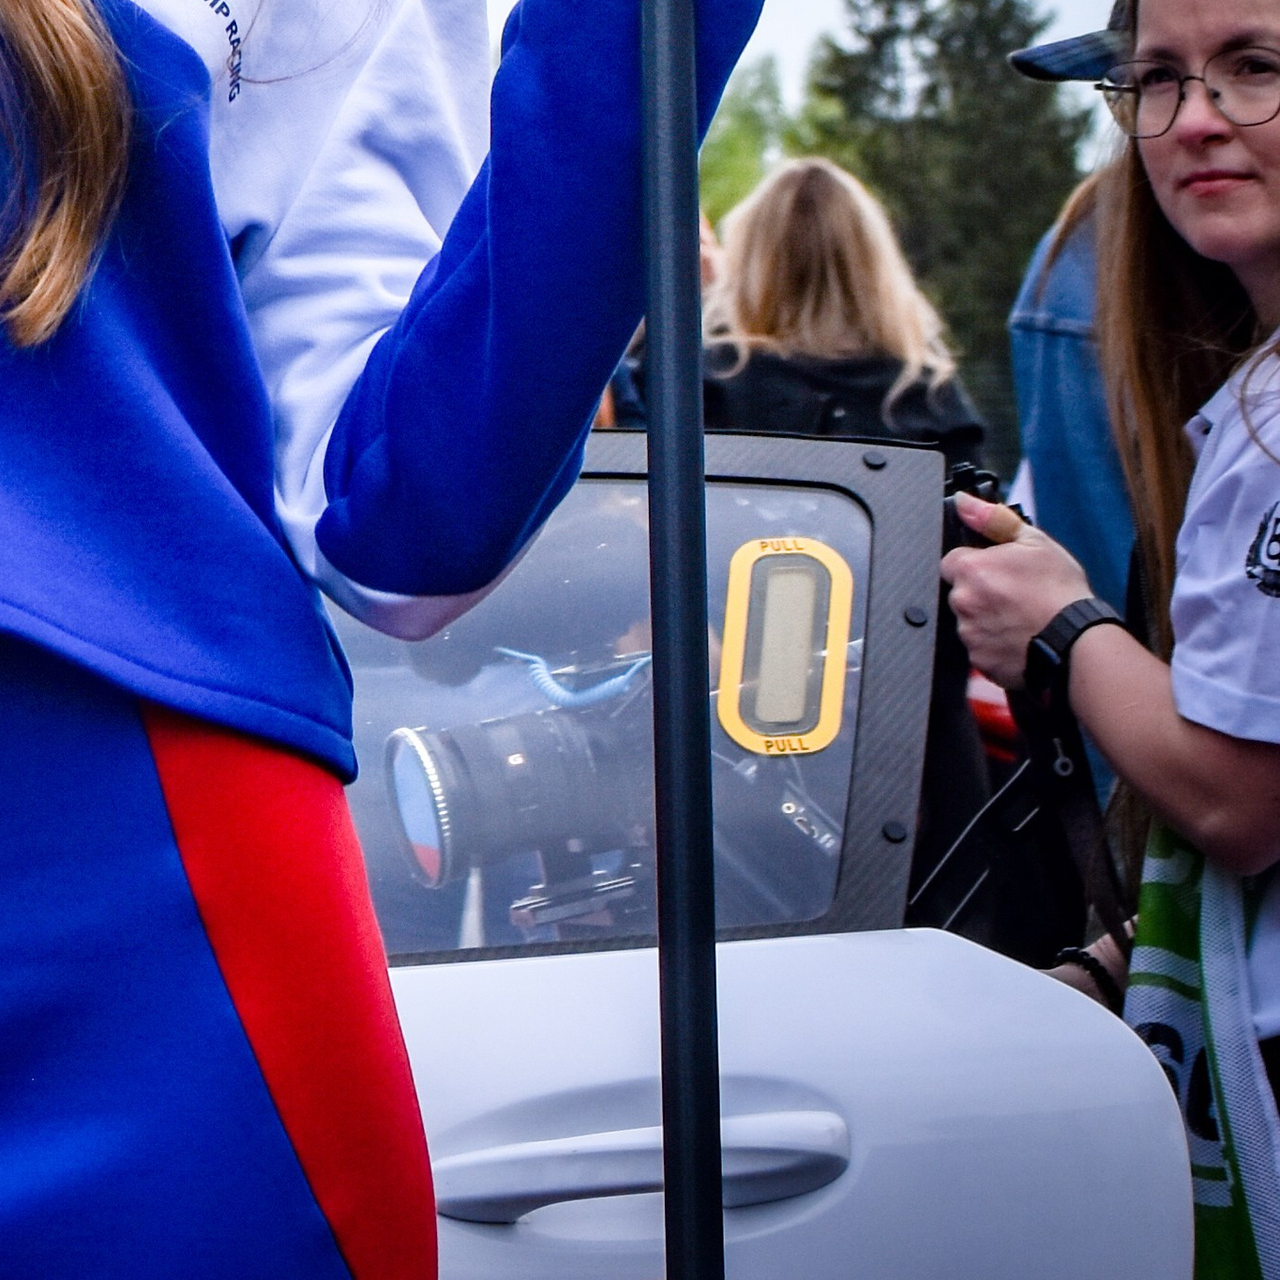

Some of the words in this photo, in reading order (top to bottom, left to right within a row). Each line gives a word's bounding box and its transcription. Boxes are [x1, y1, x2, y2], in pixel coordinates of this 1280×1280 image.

[225, 19, 242, 103] RACING
[760, 540, 805, 552] PULL
[764, 738, 810, 752] PULL
